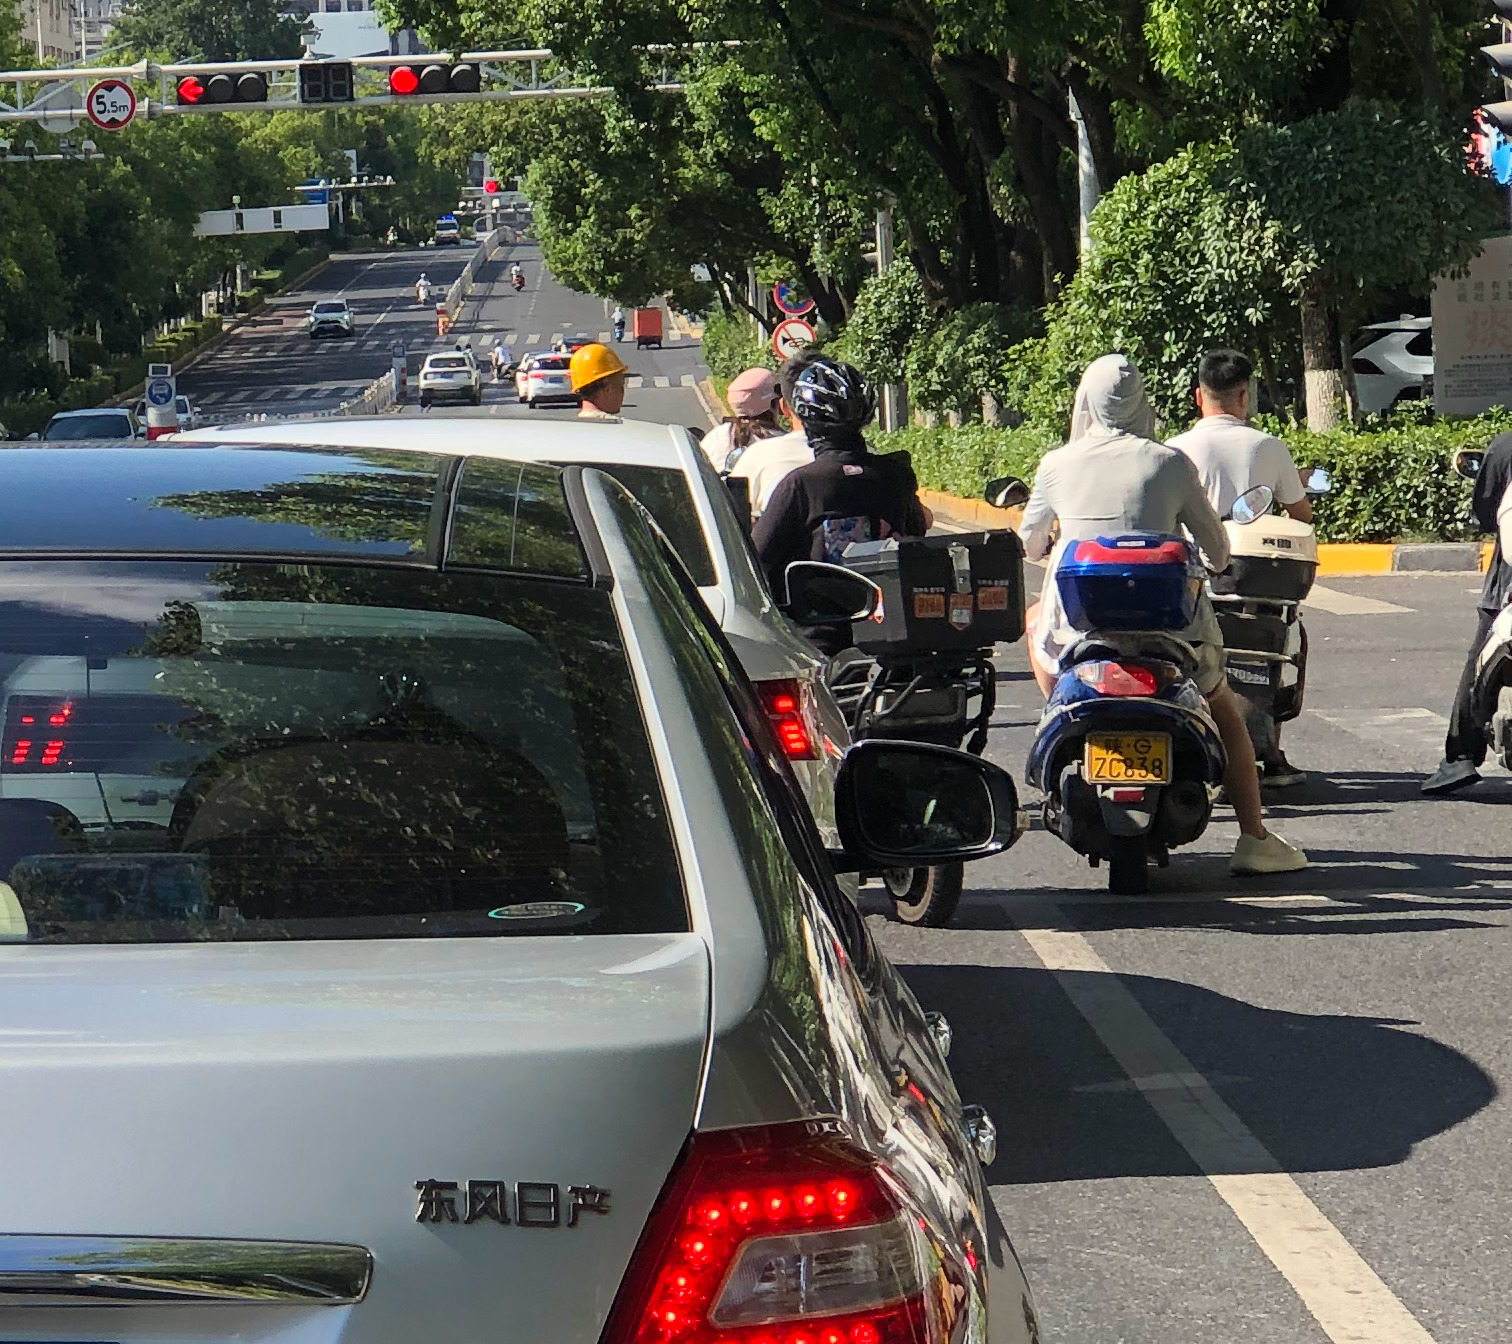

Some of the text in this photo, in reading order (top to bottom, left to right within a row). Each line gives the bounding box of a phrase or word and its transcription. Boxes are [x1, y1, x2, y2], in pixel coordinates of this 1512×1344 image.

[95, 94, 129, 115] 5.5m
[1094, 757, 1163, 779] ZC838
[414, 1178, 612, 1228] 东风日产
